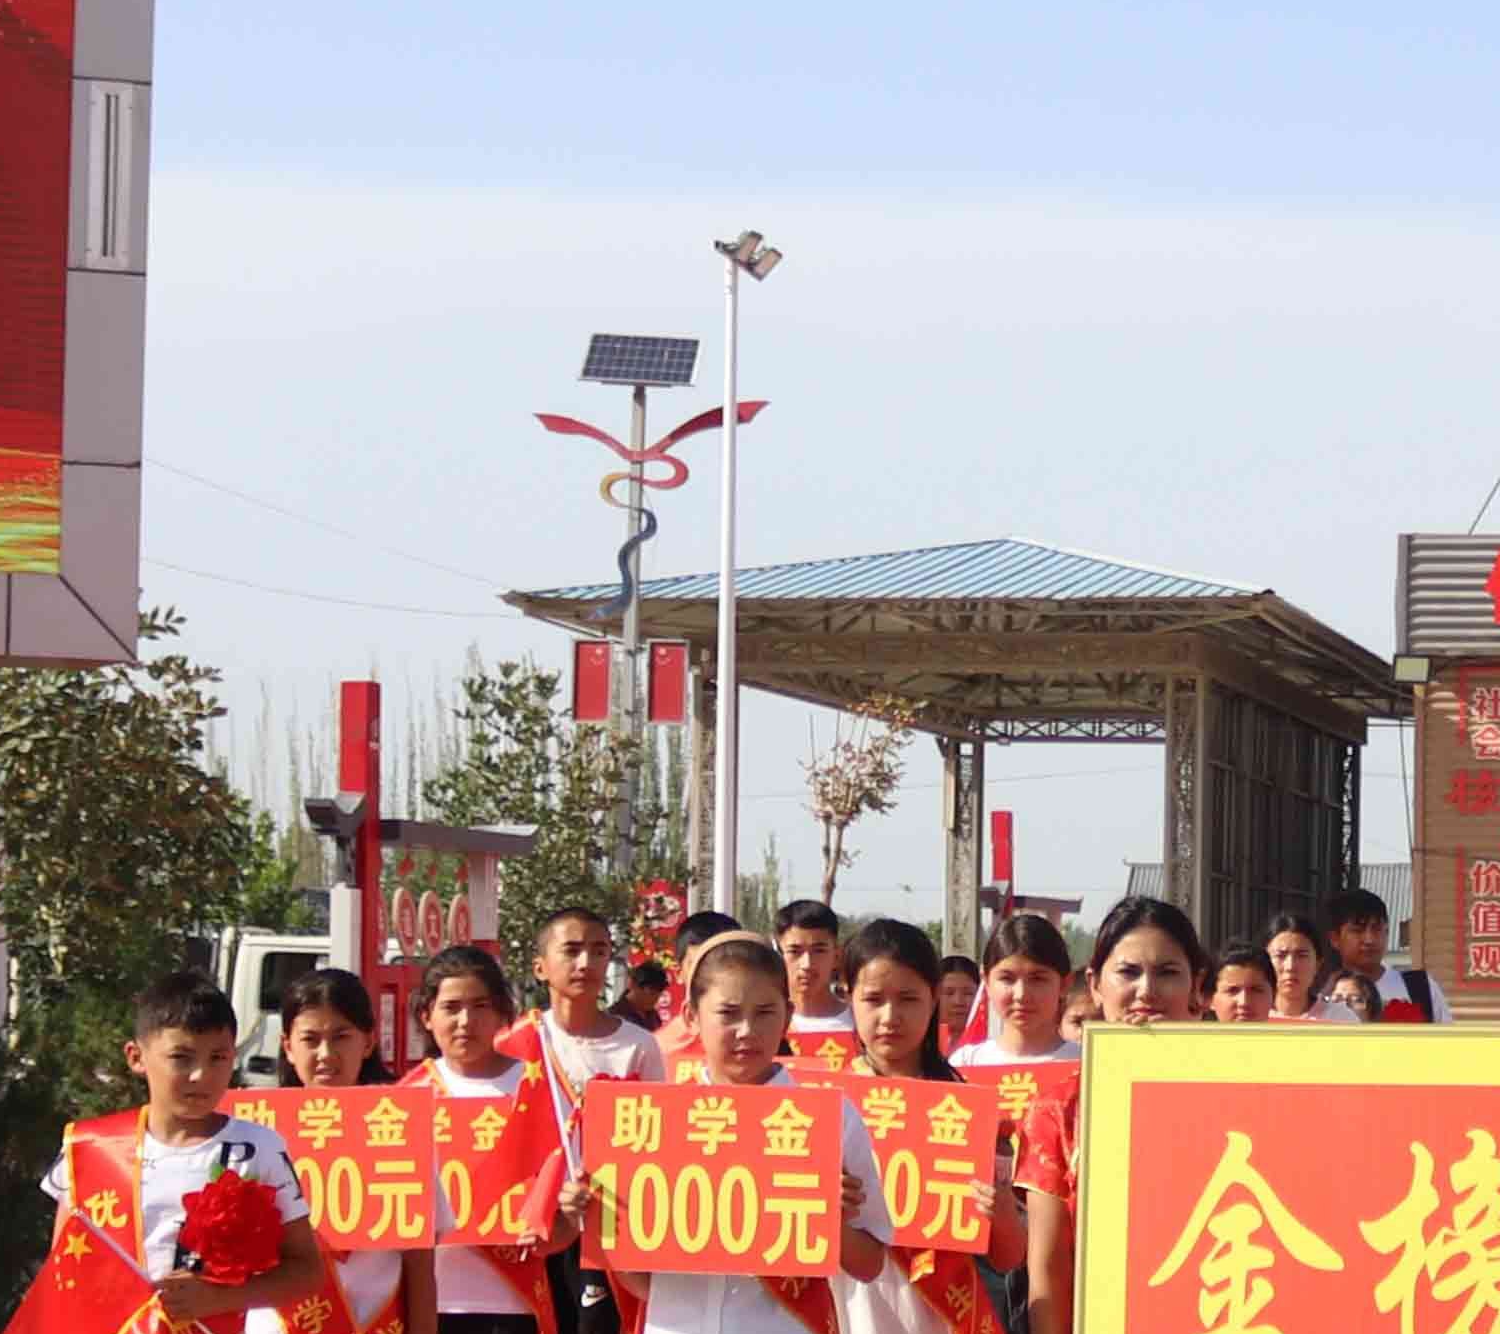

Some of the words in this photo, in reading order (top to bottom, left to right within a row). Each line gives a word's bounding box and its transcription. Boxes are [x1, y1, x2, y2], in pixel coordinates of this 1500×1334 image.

[611, 1096, 814, 1157] 助学金
[862, 1087, 973, 1147] 学金
[590, 1163, 829, 1266] 1000元
